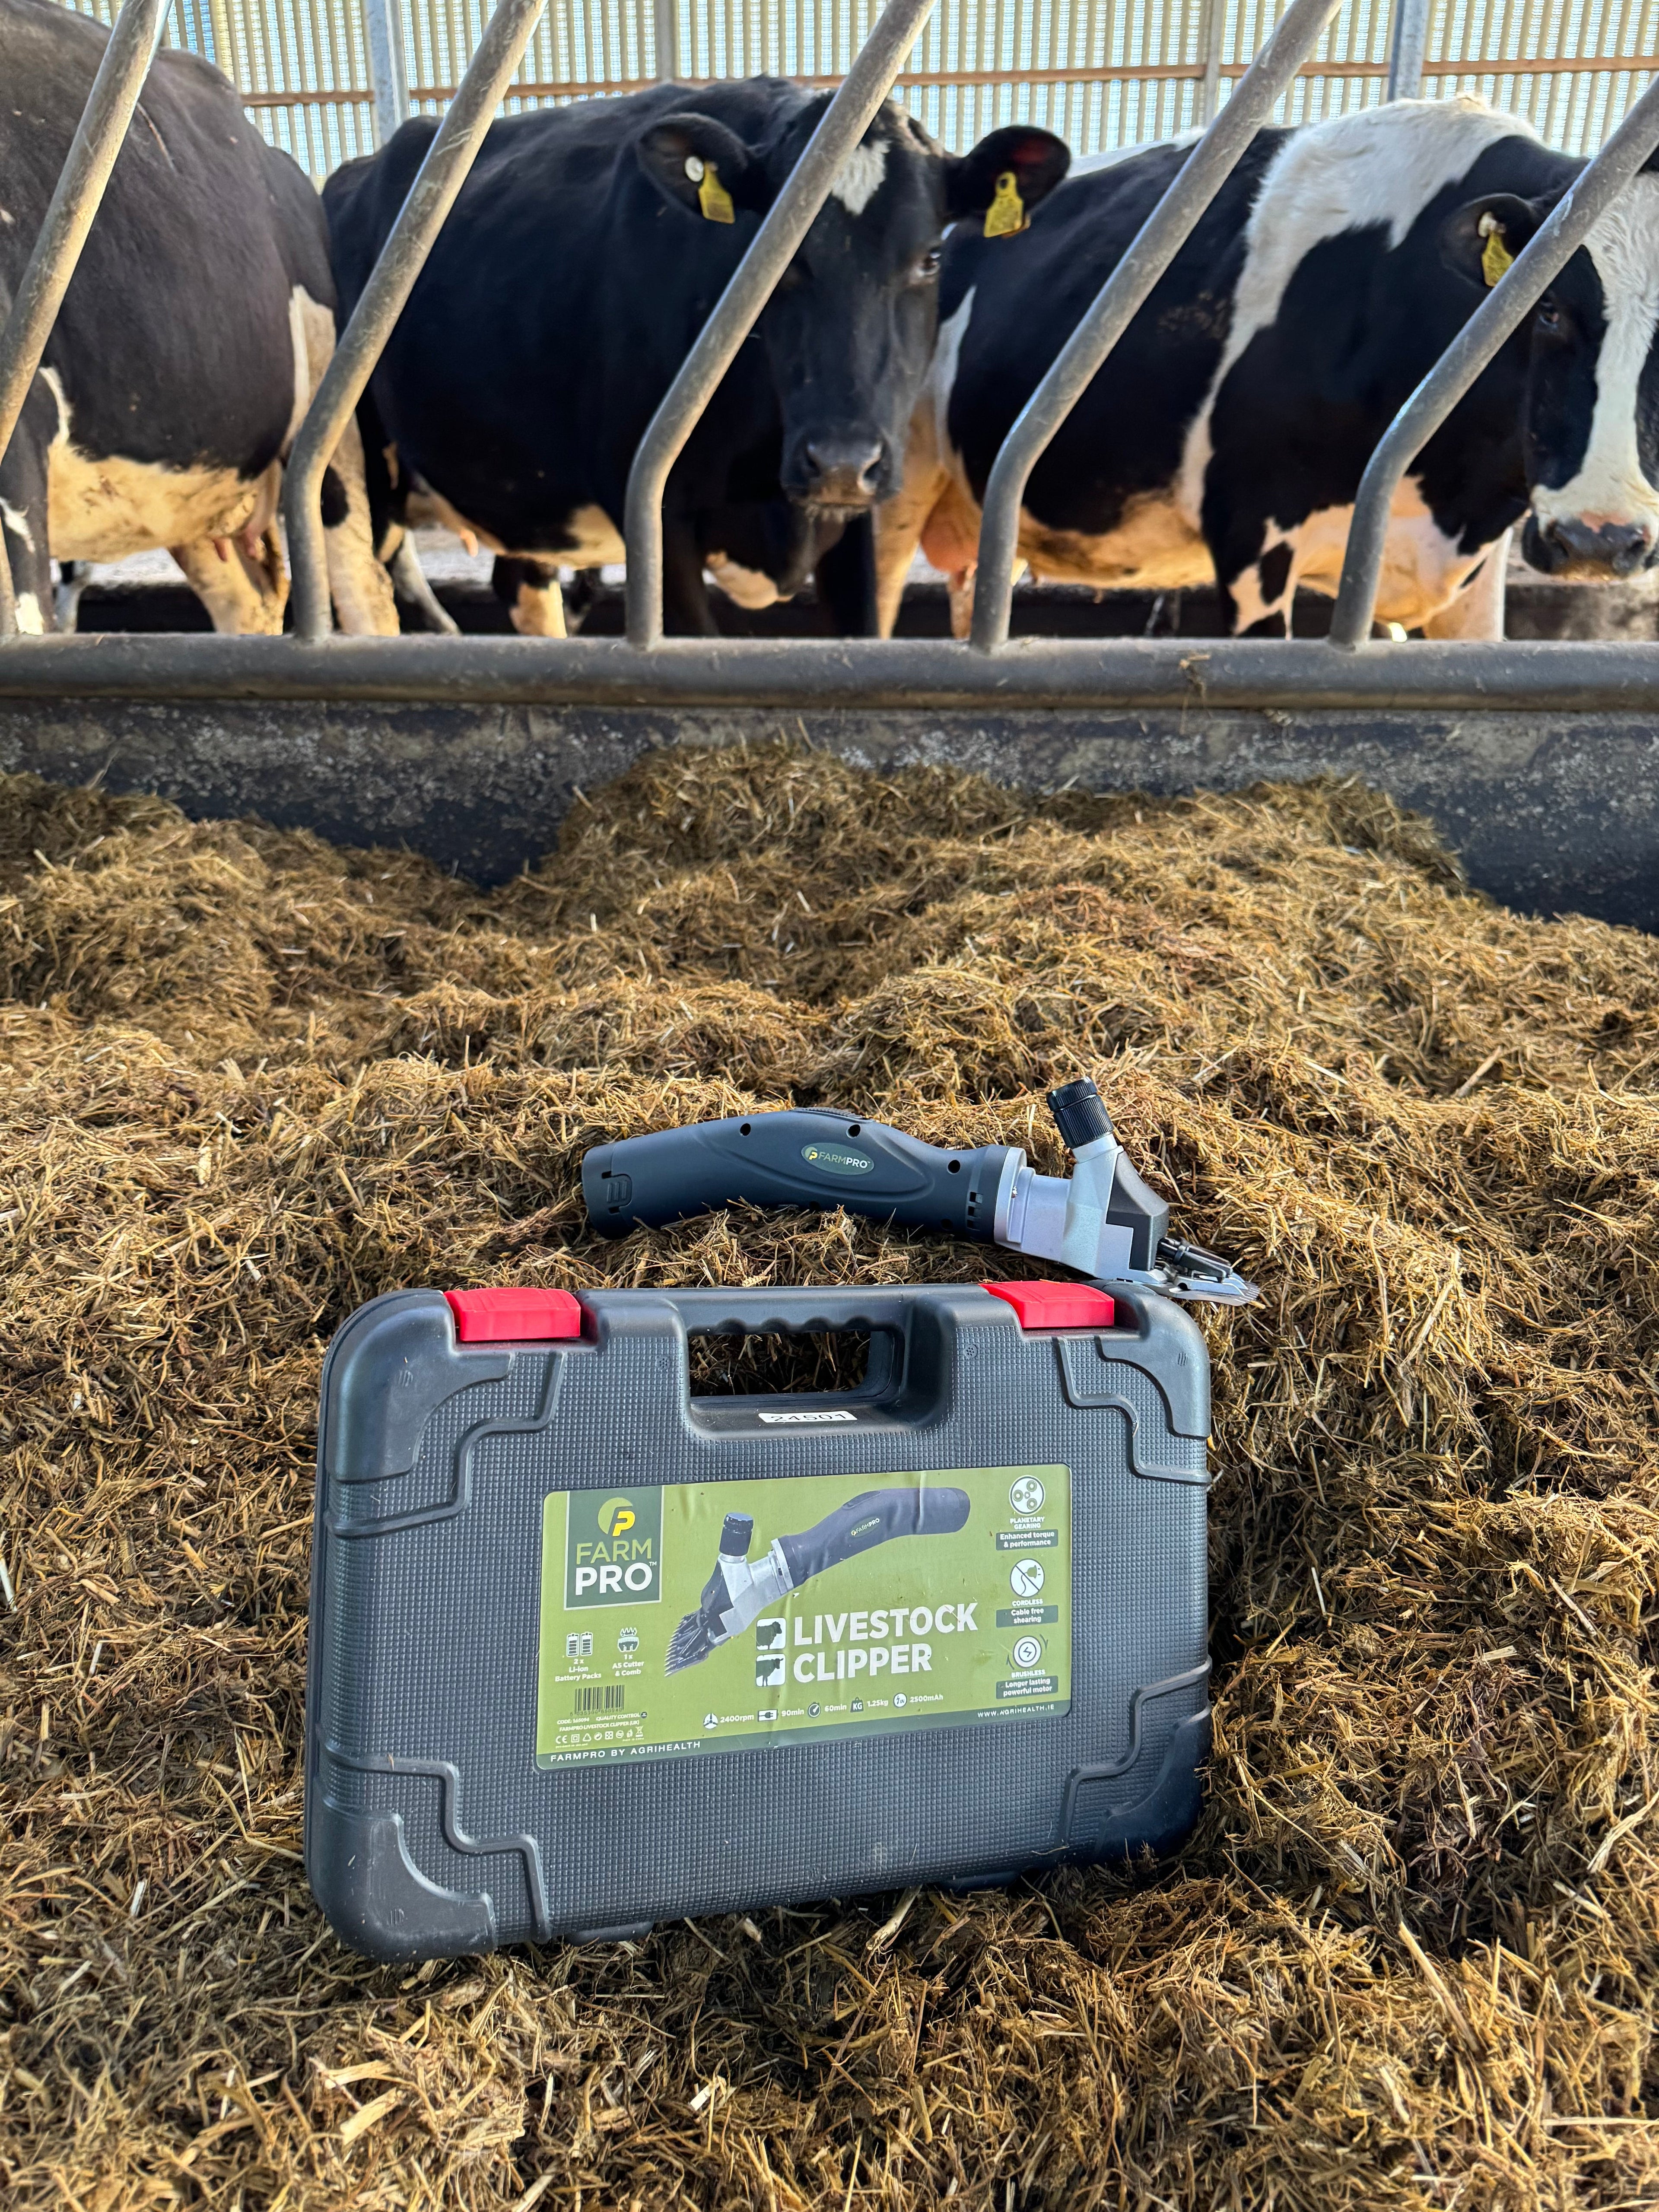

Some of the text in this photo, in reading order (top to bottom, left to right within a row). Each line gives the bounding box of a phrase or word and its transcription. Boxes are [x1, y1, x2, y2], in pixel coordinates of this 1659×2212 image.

[818, 1152, 868, 1169] FARMPRO
[855, 1518, 880, 1533] FARMPRO
[576, 1538, 652, 1564] FARM
[1010, 1540, 1051, 1548] performance
[575, 1562, 652, 1595] PRO
[794, 1602, 978, 1646] LIVESTOCK
[793, 1643, 932, 1683] CLIPPER
[1011, 1669, 1046, 1678] BRUSHLESS
[909, 1694, 944, 1703] 2500mAh
[1003, 1688, 1031, 1697] powerful
[720, 1714, 754, 1723] 2400rpm
[550, 1751, 606, 1762] FARMPRO
[630, 1741, 701, 1755] AGRIHEALTH
